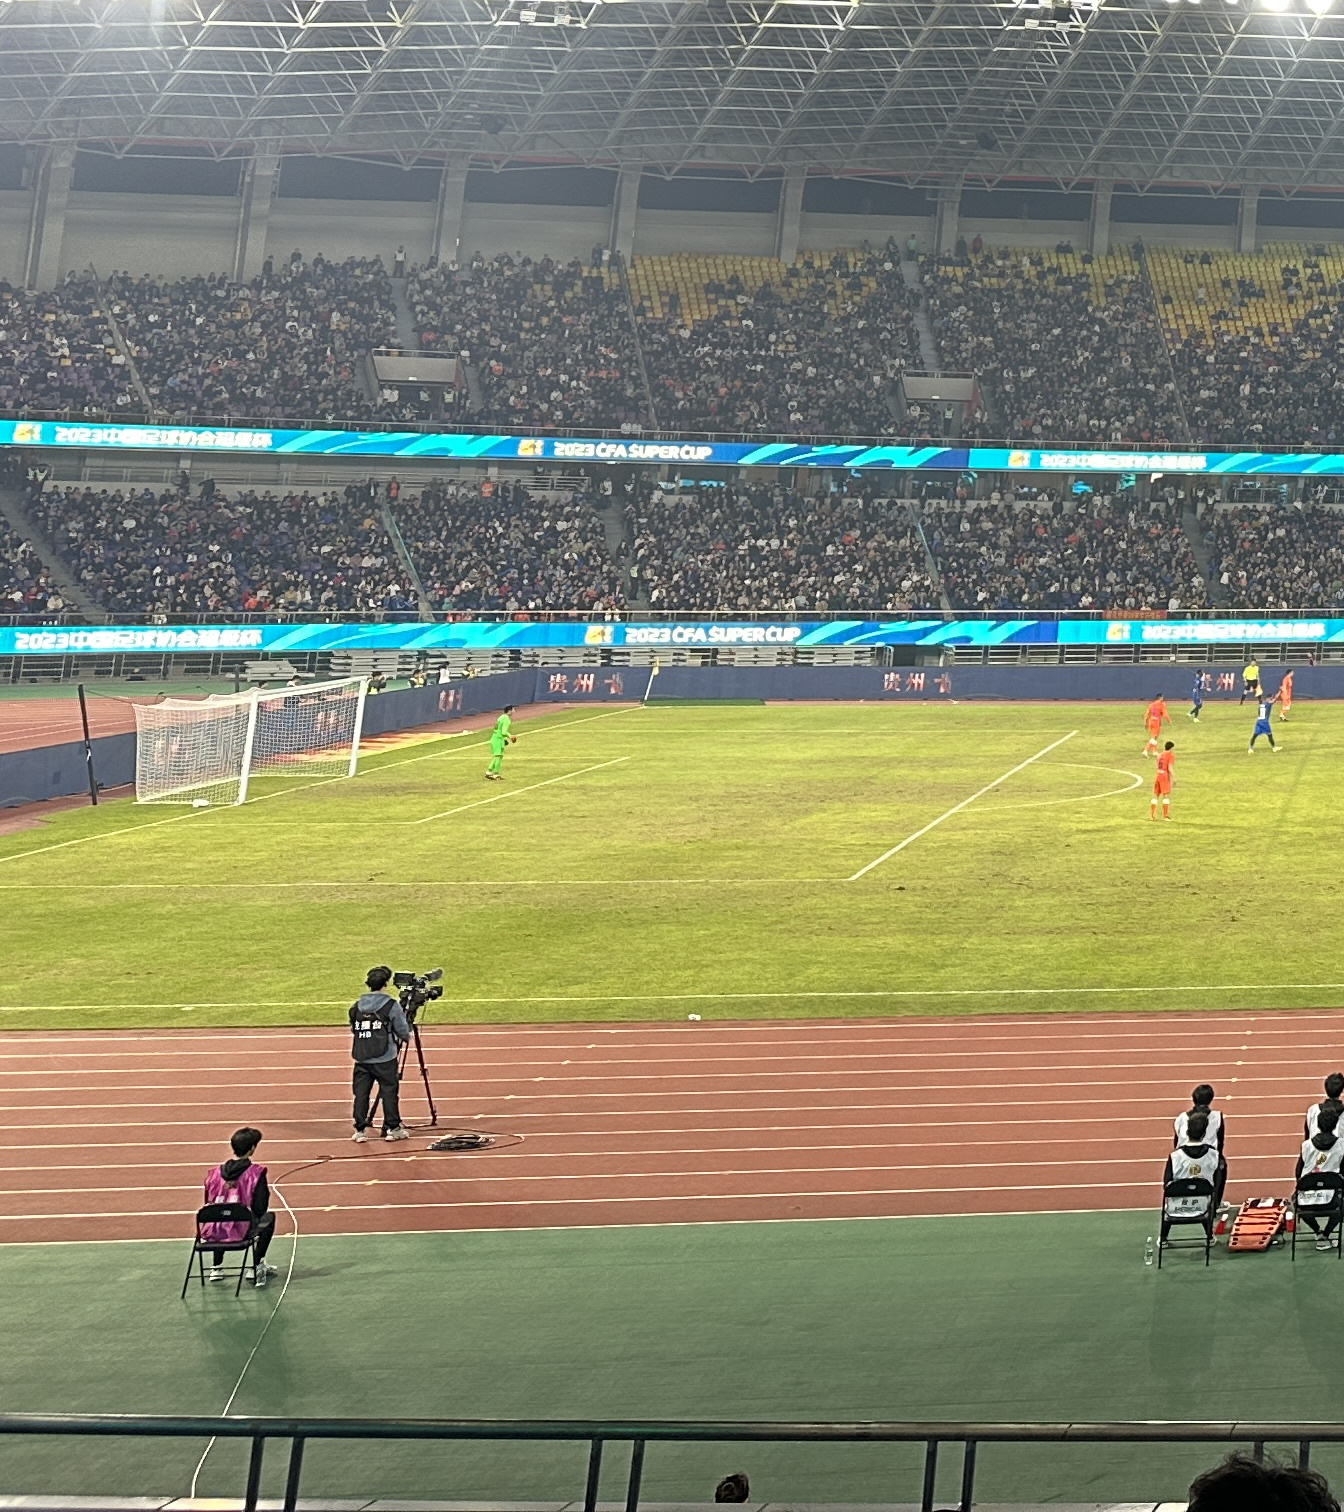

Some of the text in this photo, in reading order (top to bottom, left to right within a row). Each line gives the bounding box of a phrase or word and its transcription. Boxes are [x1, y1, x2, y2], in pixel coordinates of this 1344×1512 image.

[554, 441, 712, 460] 2023 CFA SUPER CUP
[625, 626, 801, 643] 2023 CFA SUPER CUP
